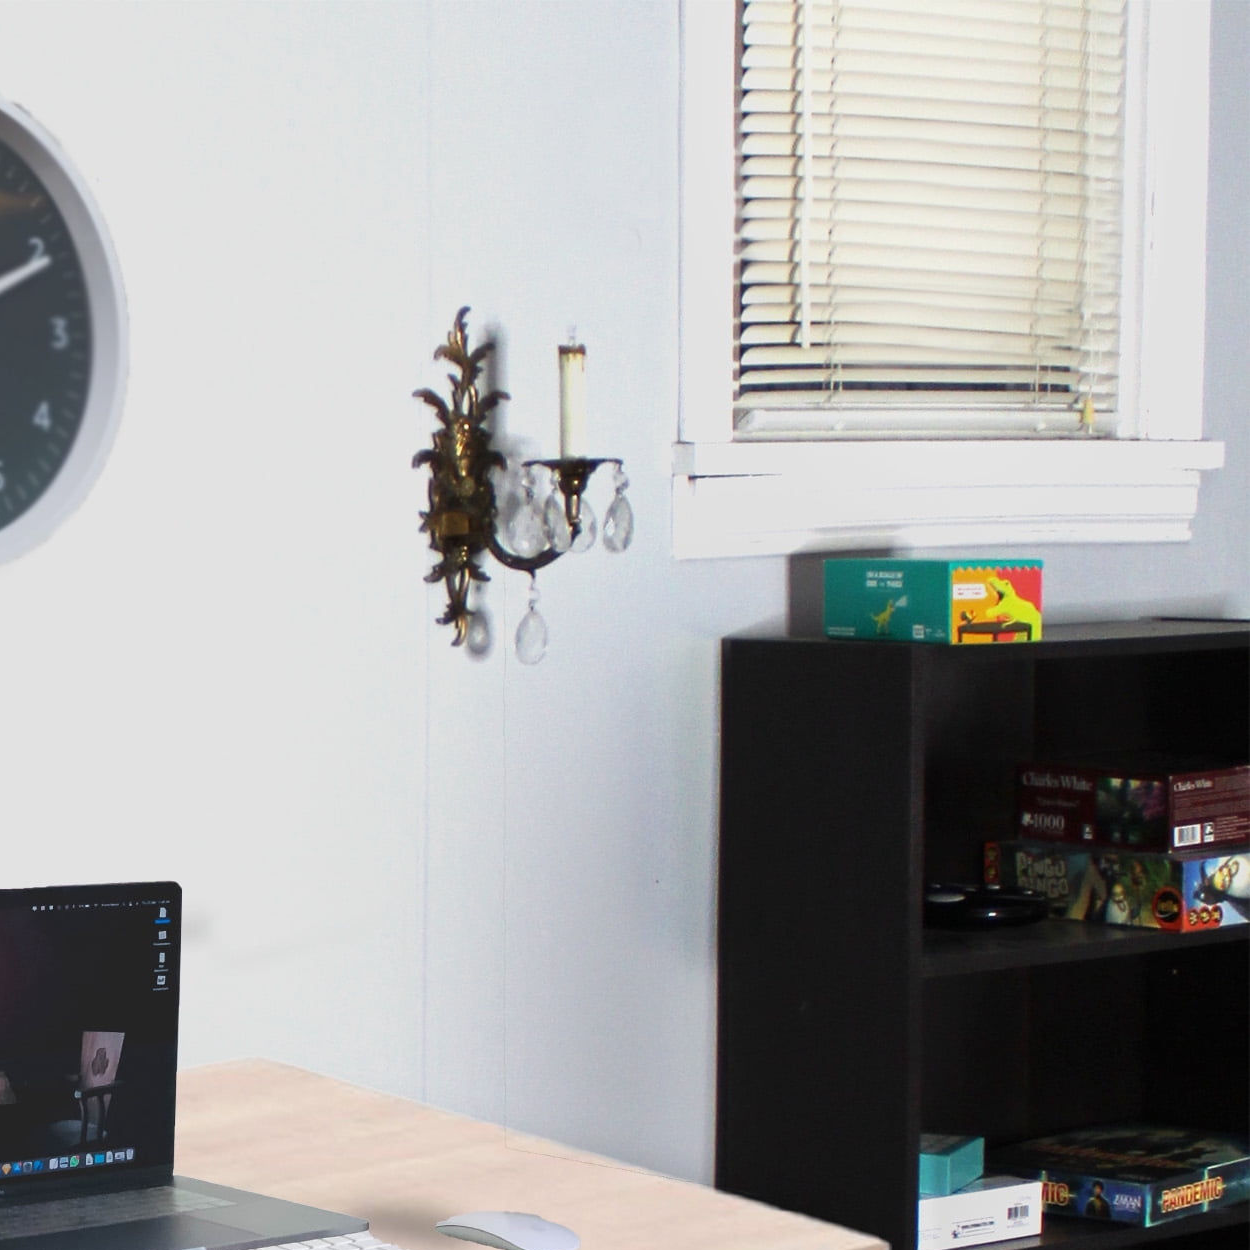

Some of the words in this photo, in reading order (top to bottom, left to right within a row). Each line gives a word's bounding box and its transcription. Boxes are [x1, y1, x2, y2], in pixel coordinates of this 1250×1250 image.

[28, 237, 46, 264] 2
[51, 320, 69, 349] 3
[31, 402, 52, 430] 4
[1060, 774, 1093, 791] White
[1161, 1176, 1223, 1214] PANDEMIC
